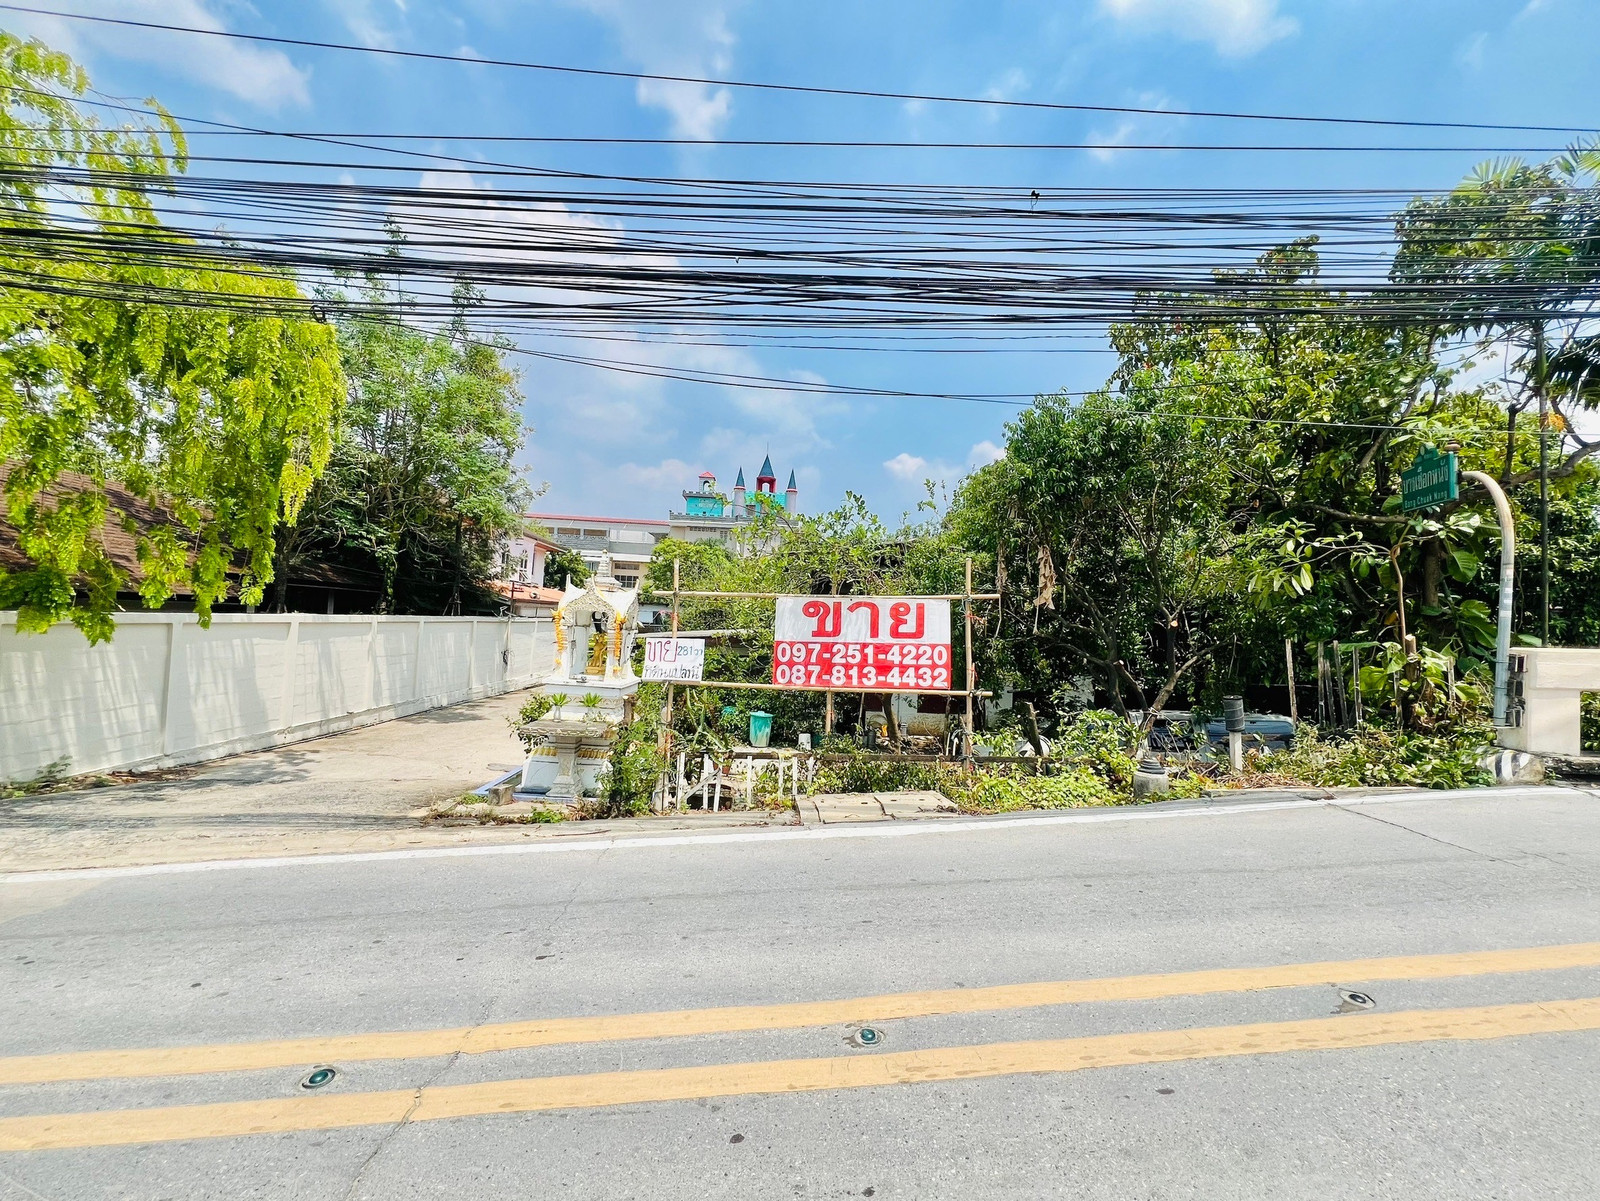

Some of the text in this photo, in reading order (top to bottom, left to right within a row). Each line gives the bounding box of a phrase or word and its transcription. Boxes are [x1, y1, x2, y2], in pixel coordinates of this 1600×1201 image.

[1403, 459, 1449, 494] บางเชือกหนัง
[1405, 491, 1448, 509] Bang Chuak Nang
[802, 600, 925, 639] ขาย
[647, 640, 678, 662] ขาย
[776, 642, 948, 665] 097-251-4220
[775, 664, 948, 687] 087-813-4432
